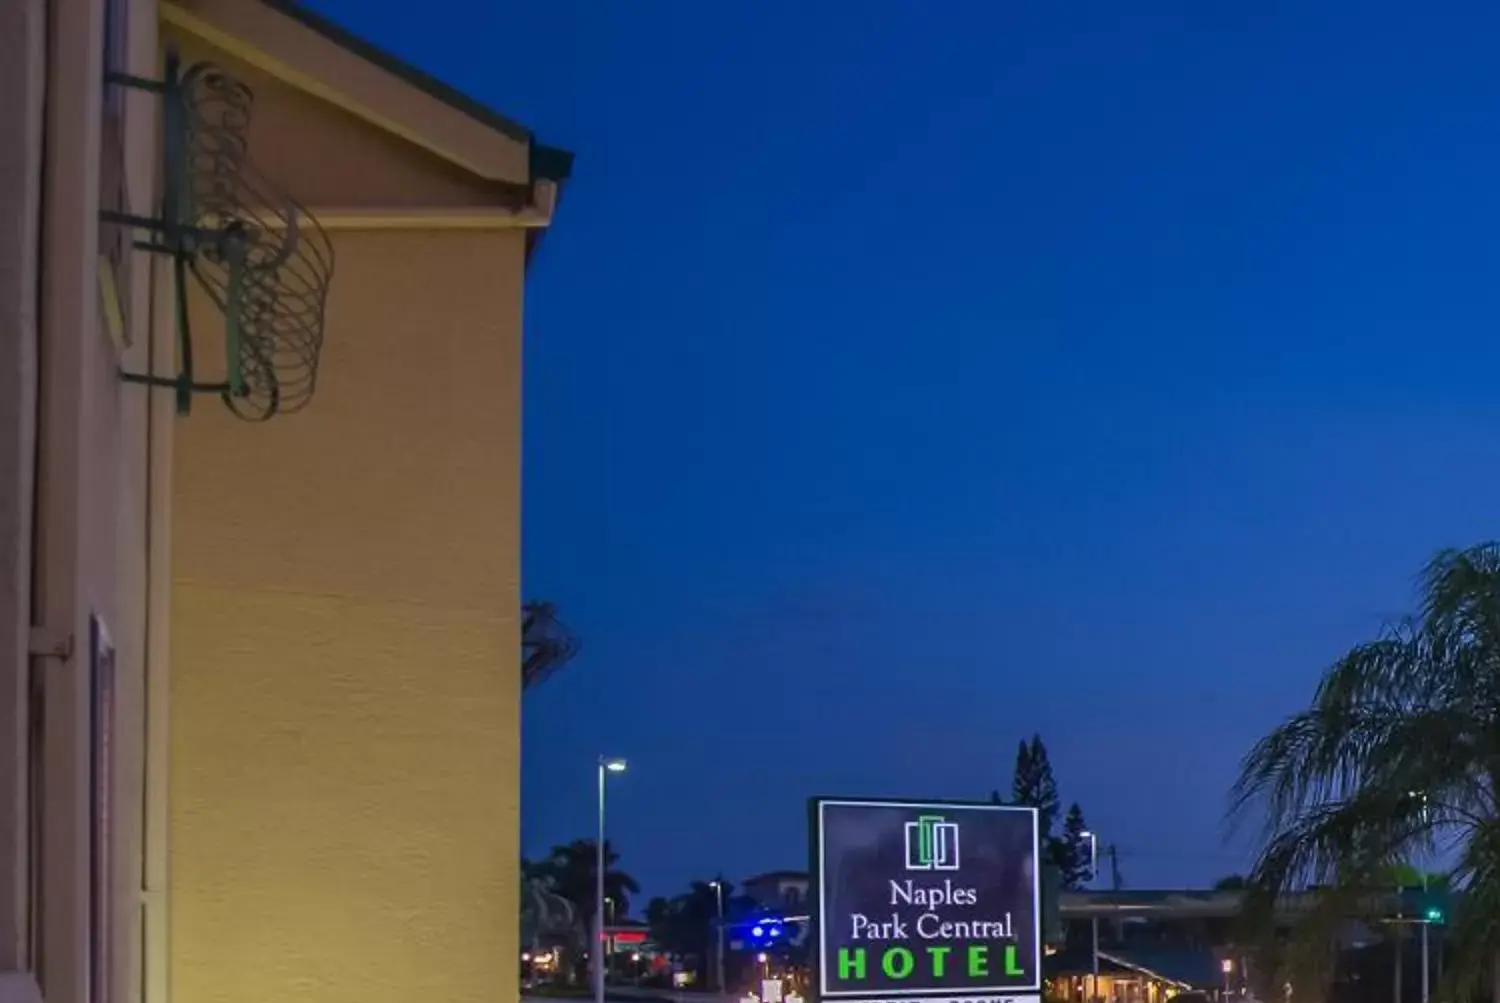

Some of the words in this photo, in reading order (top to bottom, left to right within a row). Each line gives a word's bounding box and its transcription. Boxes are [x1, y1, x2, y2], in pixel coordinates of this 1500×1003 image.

[890, 879, 977, 910] Naples
[851, 912, 909, 939] Park
[916, 912, 1013, 939] Central
[838, 945, 1025, 980] HOTEL
